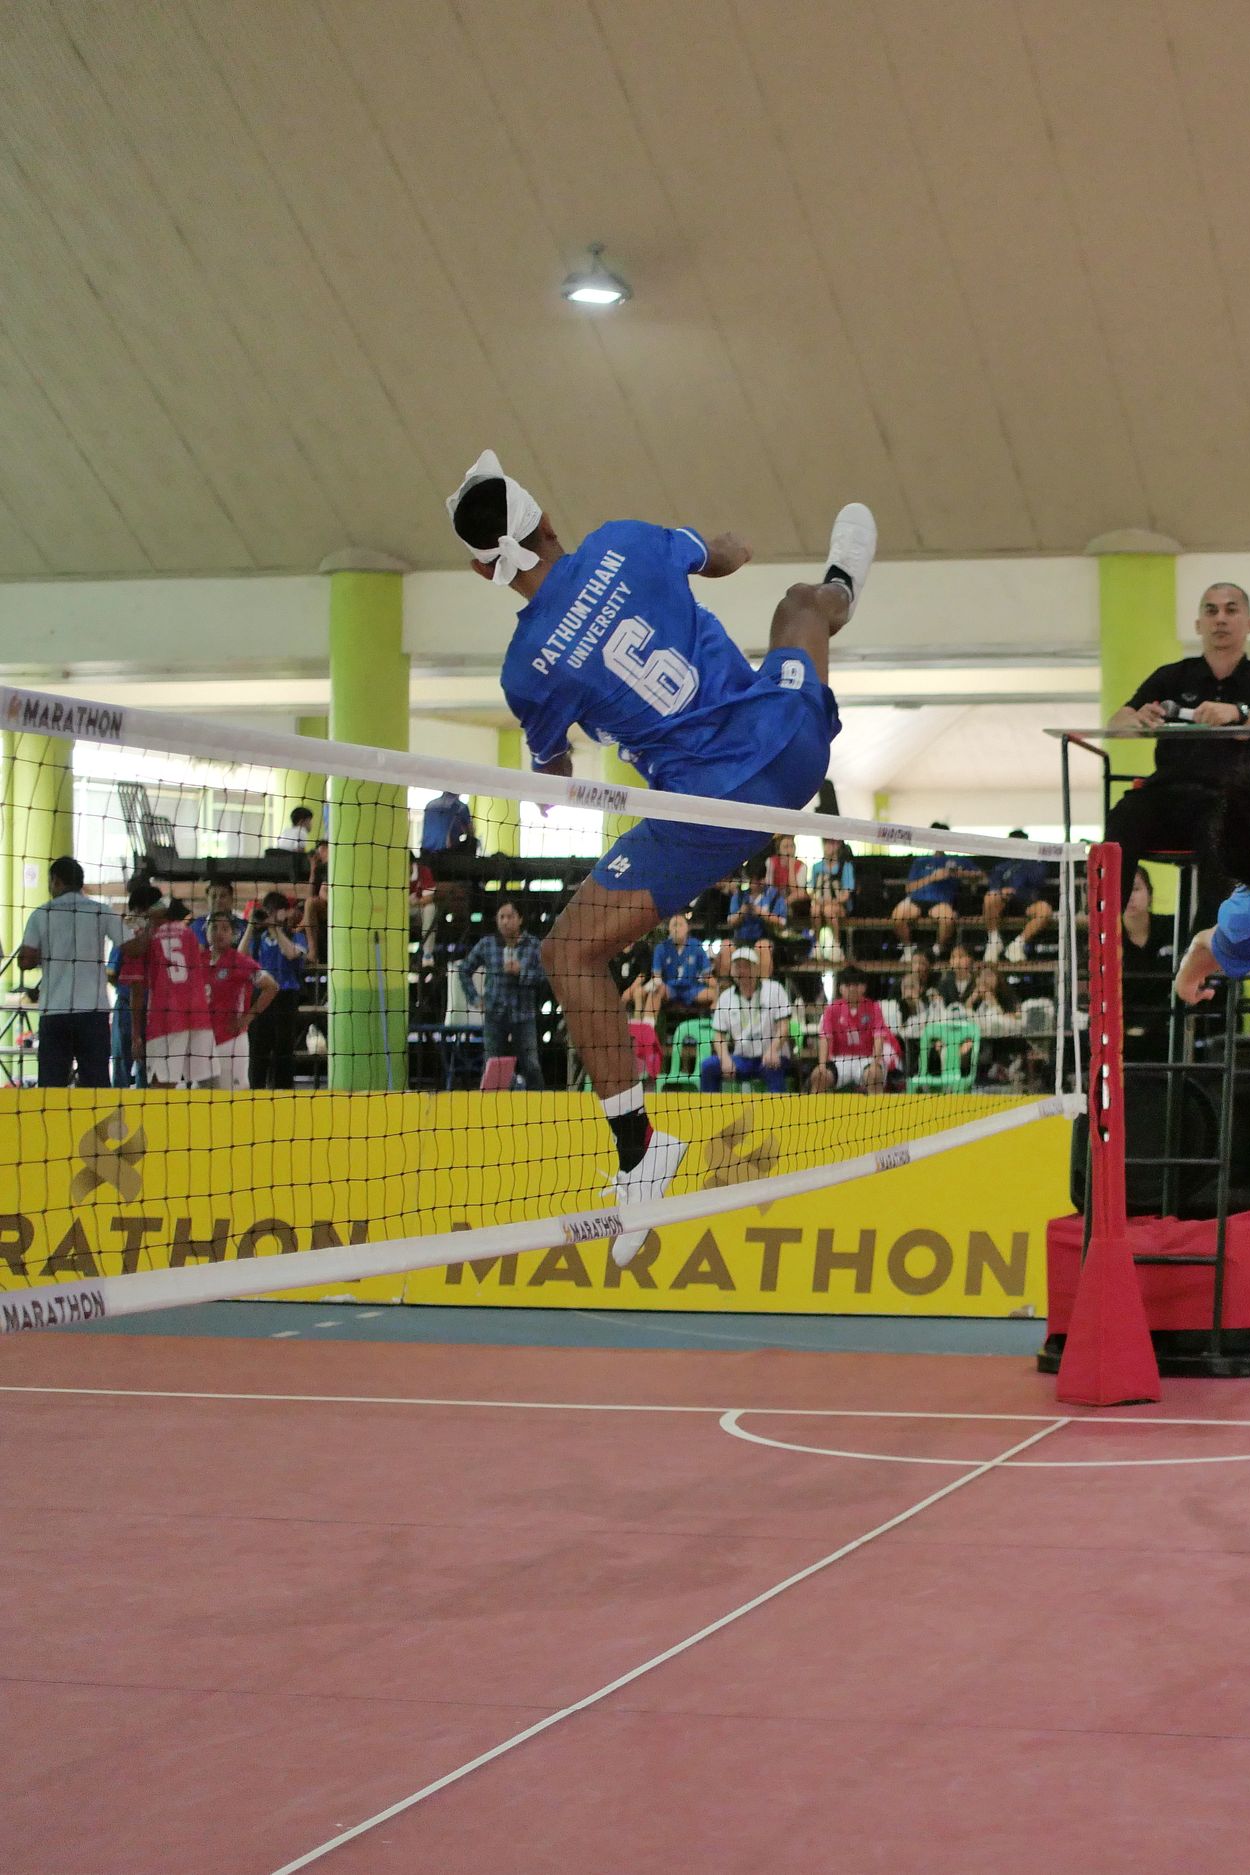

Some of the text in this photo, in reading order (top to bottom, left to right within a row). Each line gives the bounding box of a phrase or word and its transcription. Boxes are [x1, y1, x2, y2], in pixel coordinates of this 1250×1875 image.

[530, 548, 627, 676] PATHUMTHANI
[566, 580, 633, 670] UNIVERSITY
[602, 615, 701, 718] 6
[22, 697, 124, 740] MARATHON
[576, 785, 628, 811] MARATHON
[160, 937, 189, 984] 5
[570, 1214, 624, 1242] MARATHON
[2, 1289, 106, 1333] MARATHON
